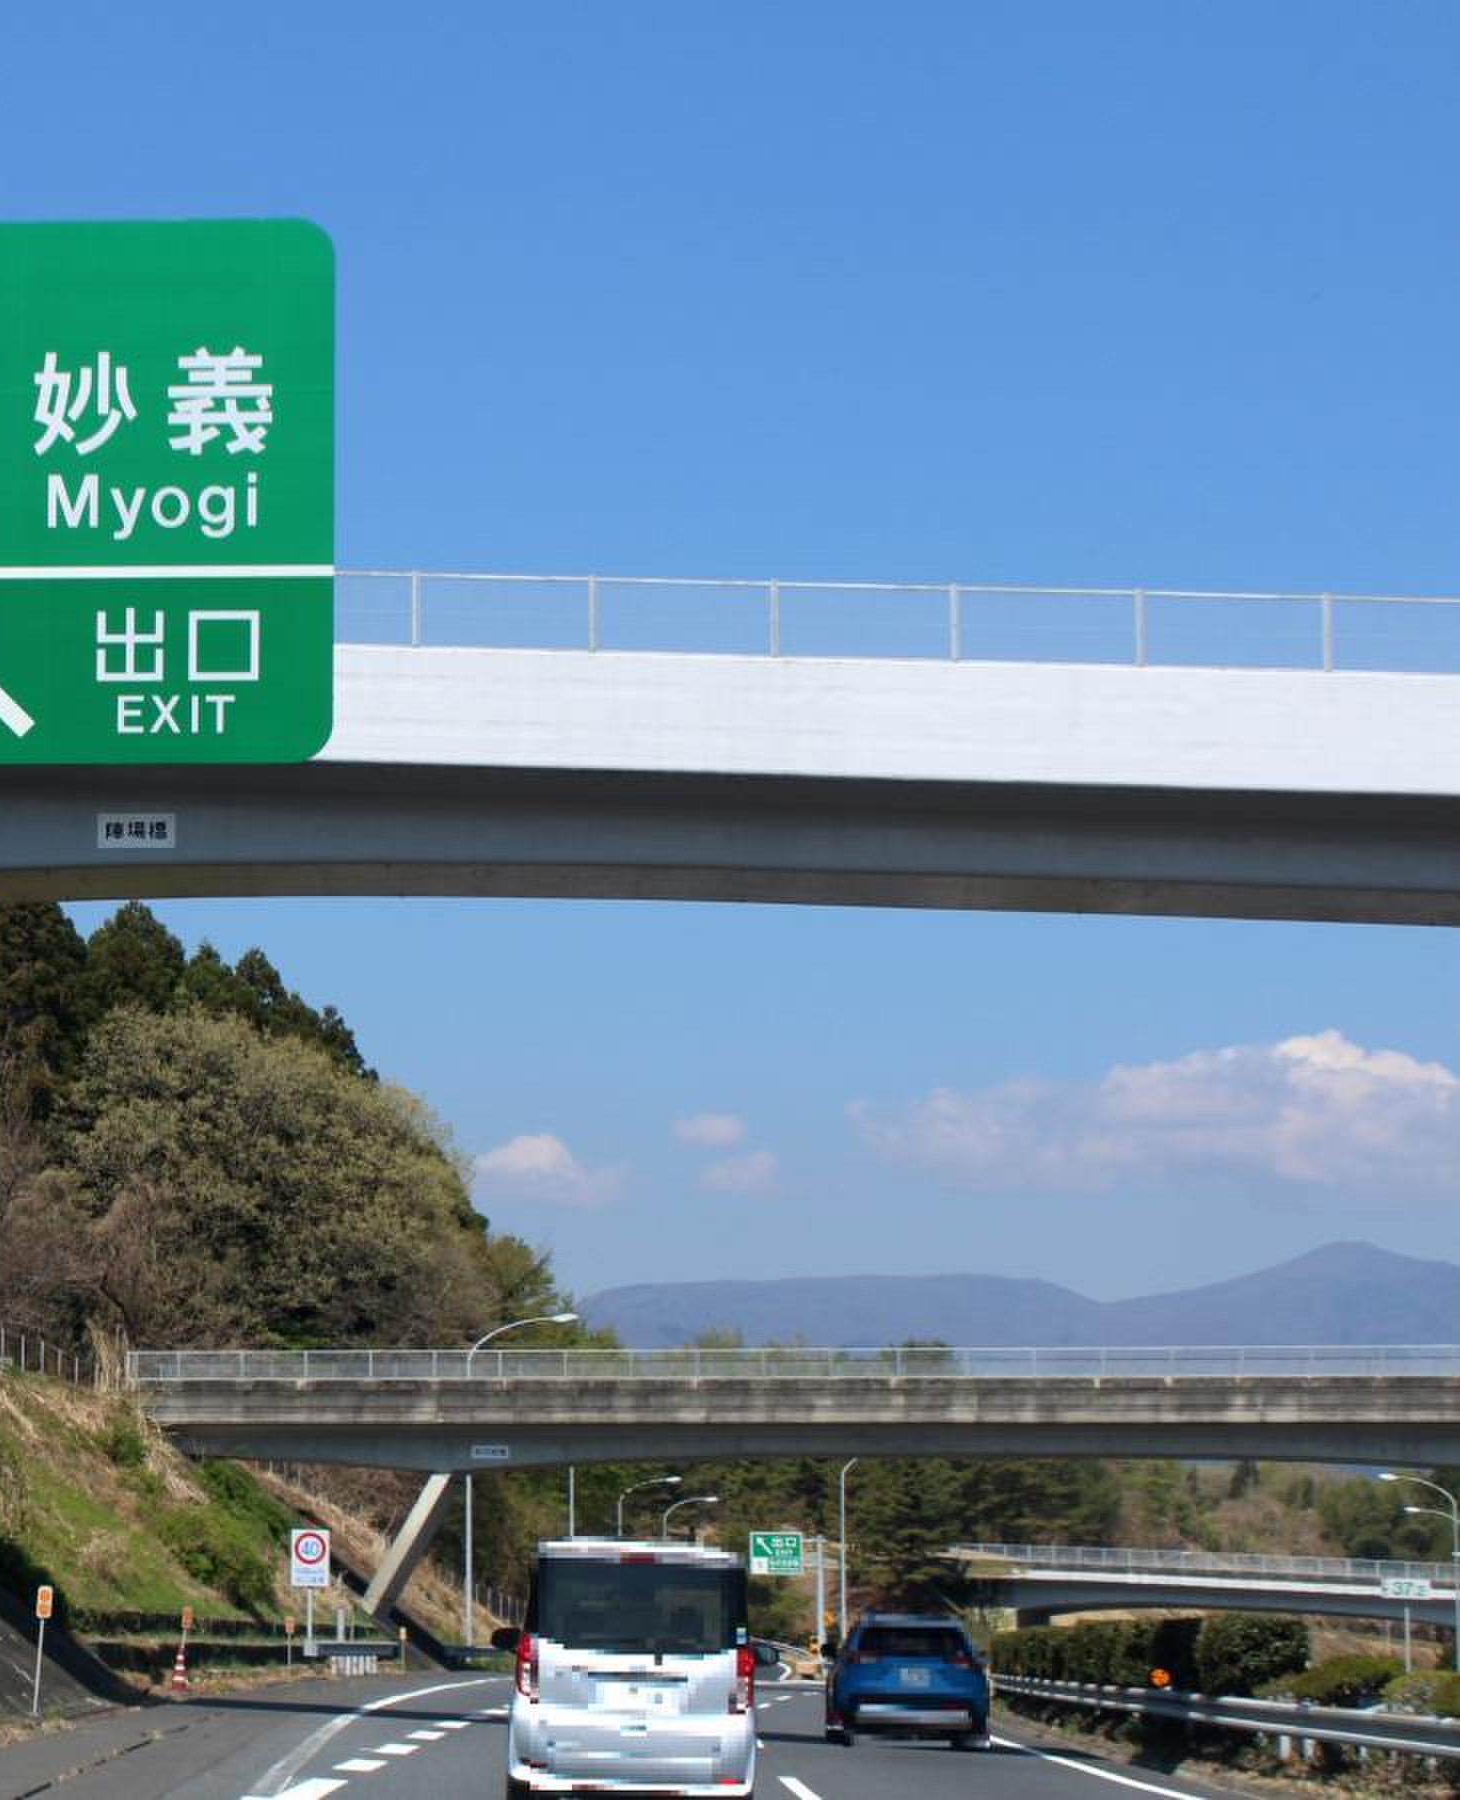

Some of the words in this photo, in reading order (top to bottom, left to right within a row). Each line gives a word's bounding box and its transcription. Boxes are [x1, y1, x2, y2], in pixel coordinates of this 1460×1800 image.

[33, 346, 274, 455] 妙義
[46, 473, 259, 539] Myogi
[96, 607, 260, 683] 出口
[117, 694, 237, 735] EXIT
